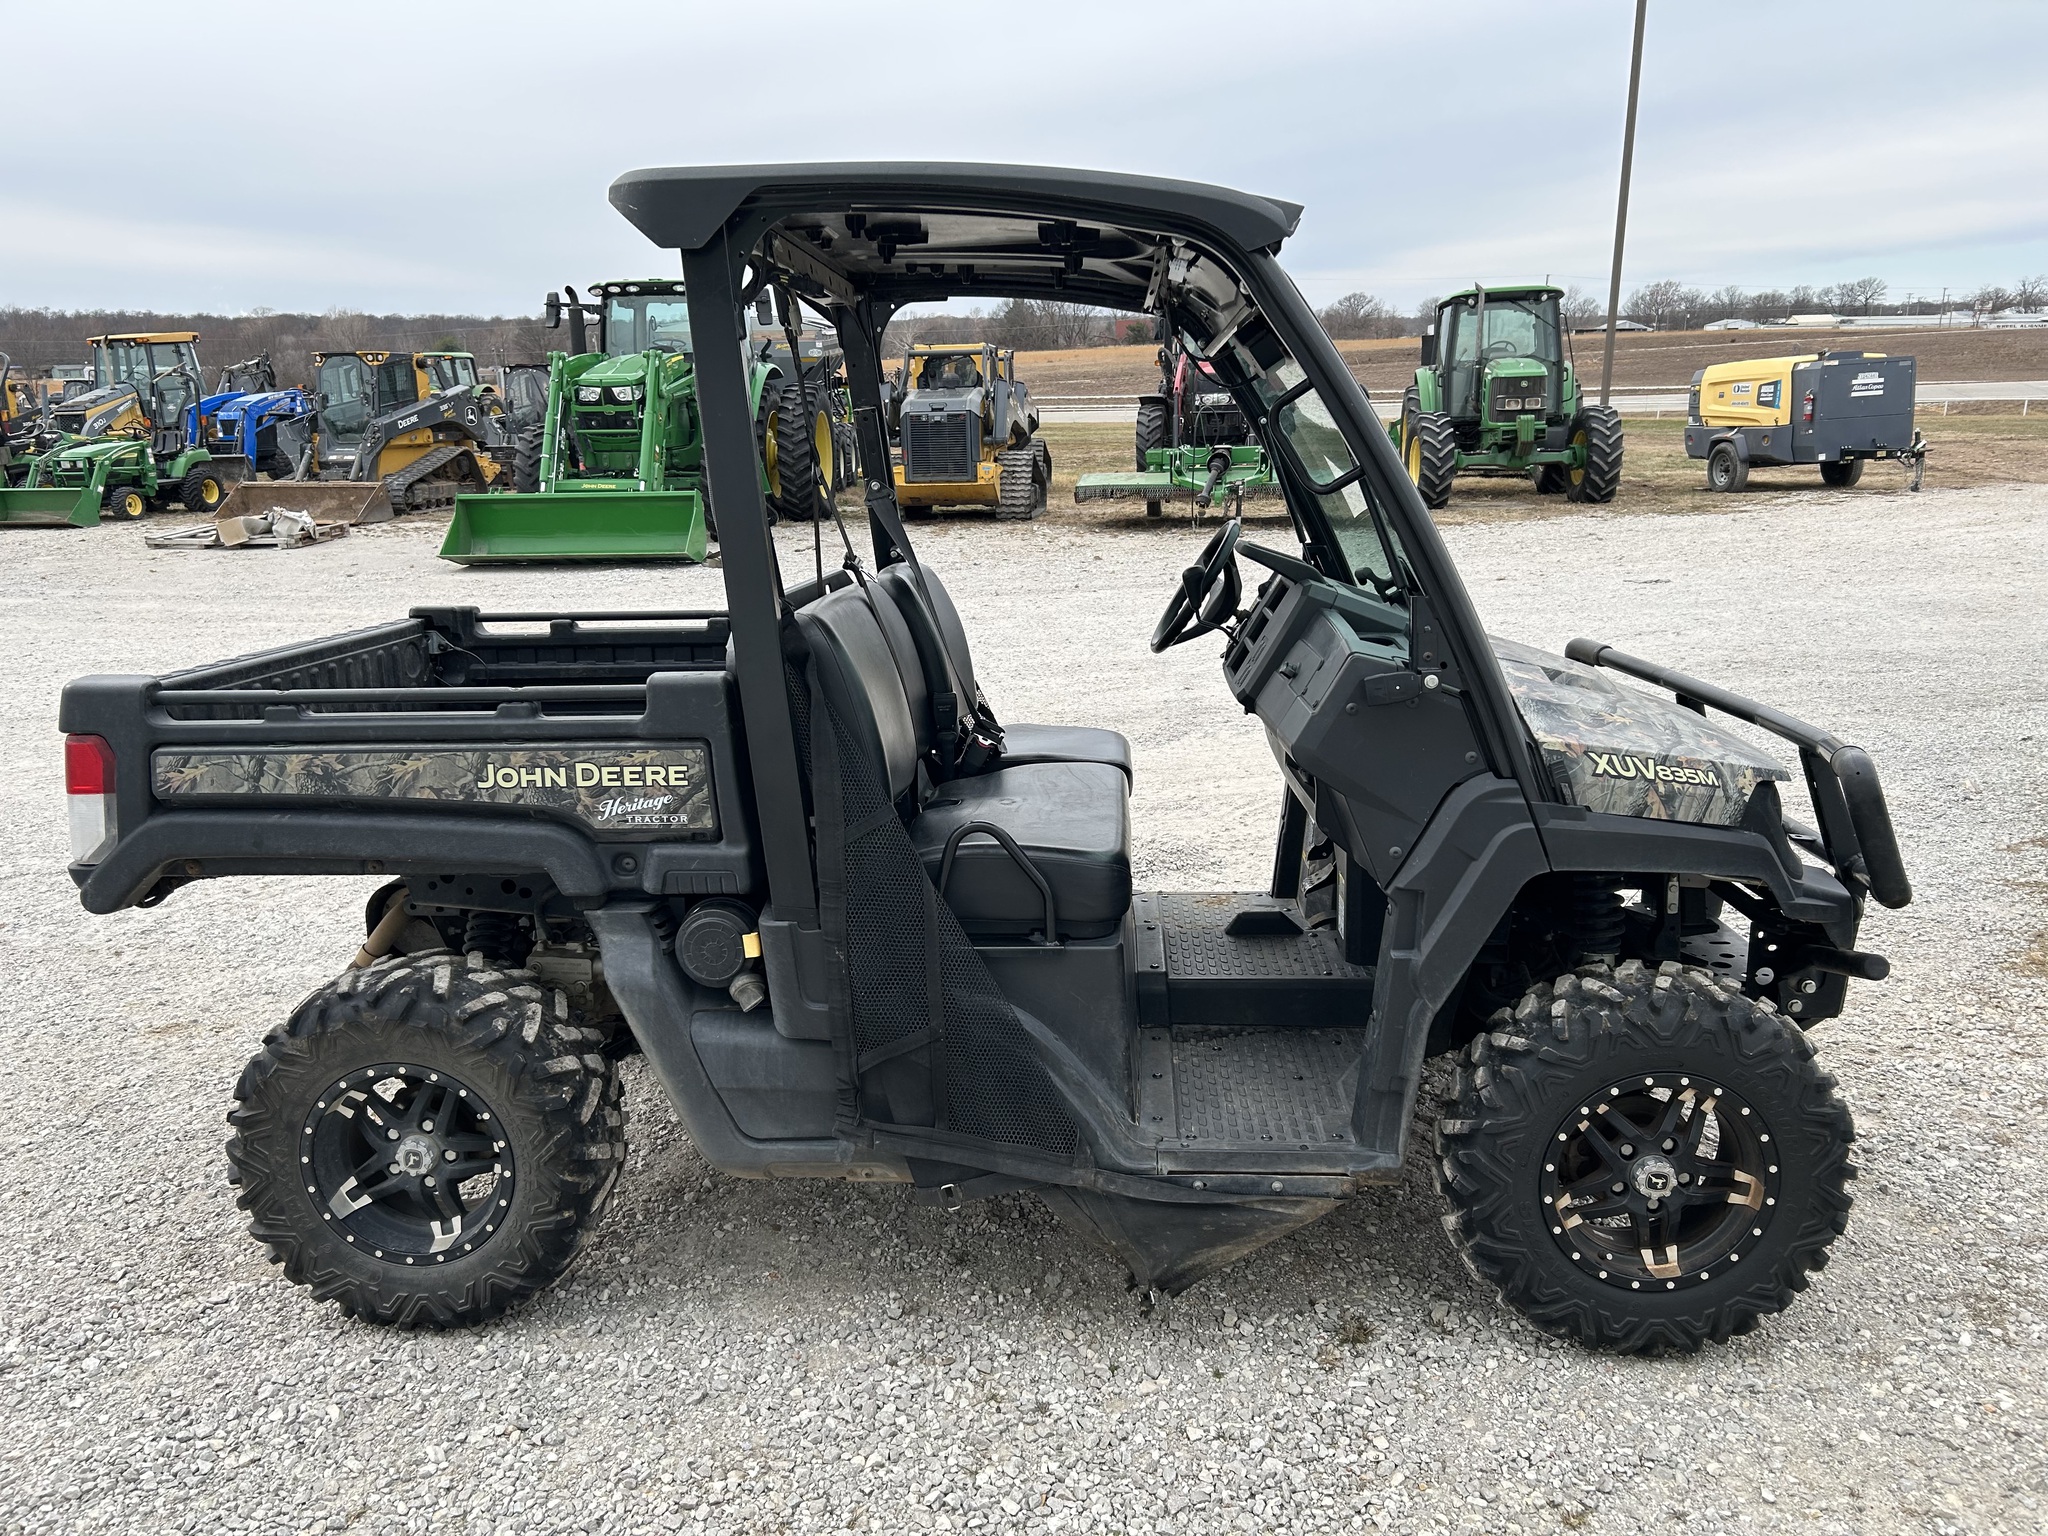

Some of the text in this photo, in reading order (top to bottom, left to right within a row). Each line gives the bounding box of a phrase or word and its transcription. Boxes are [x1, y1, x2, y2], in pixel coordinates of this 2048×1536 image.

[397, 414, 419, 430] DEERE
[477, 762, 689, 789] JOHN DEERE
[1585, 751, 1720, 787] XUV835M
[598, 794, 674, 821] Heritage
[626, 815, 688, 823] TRACTOR
